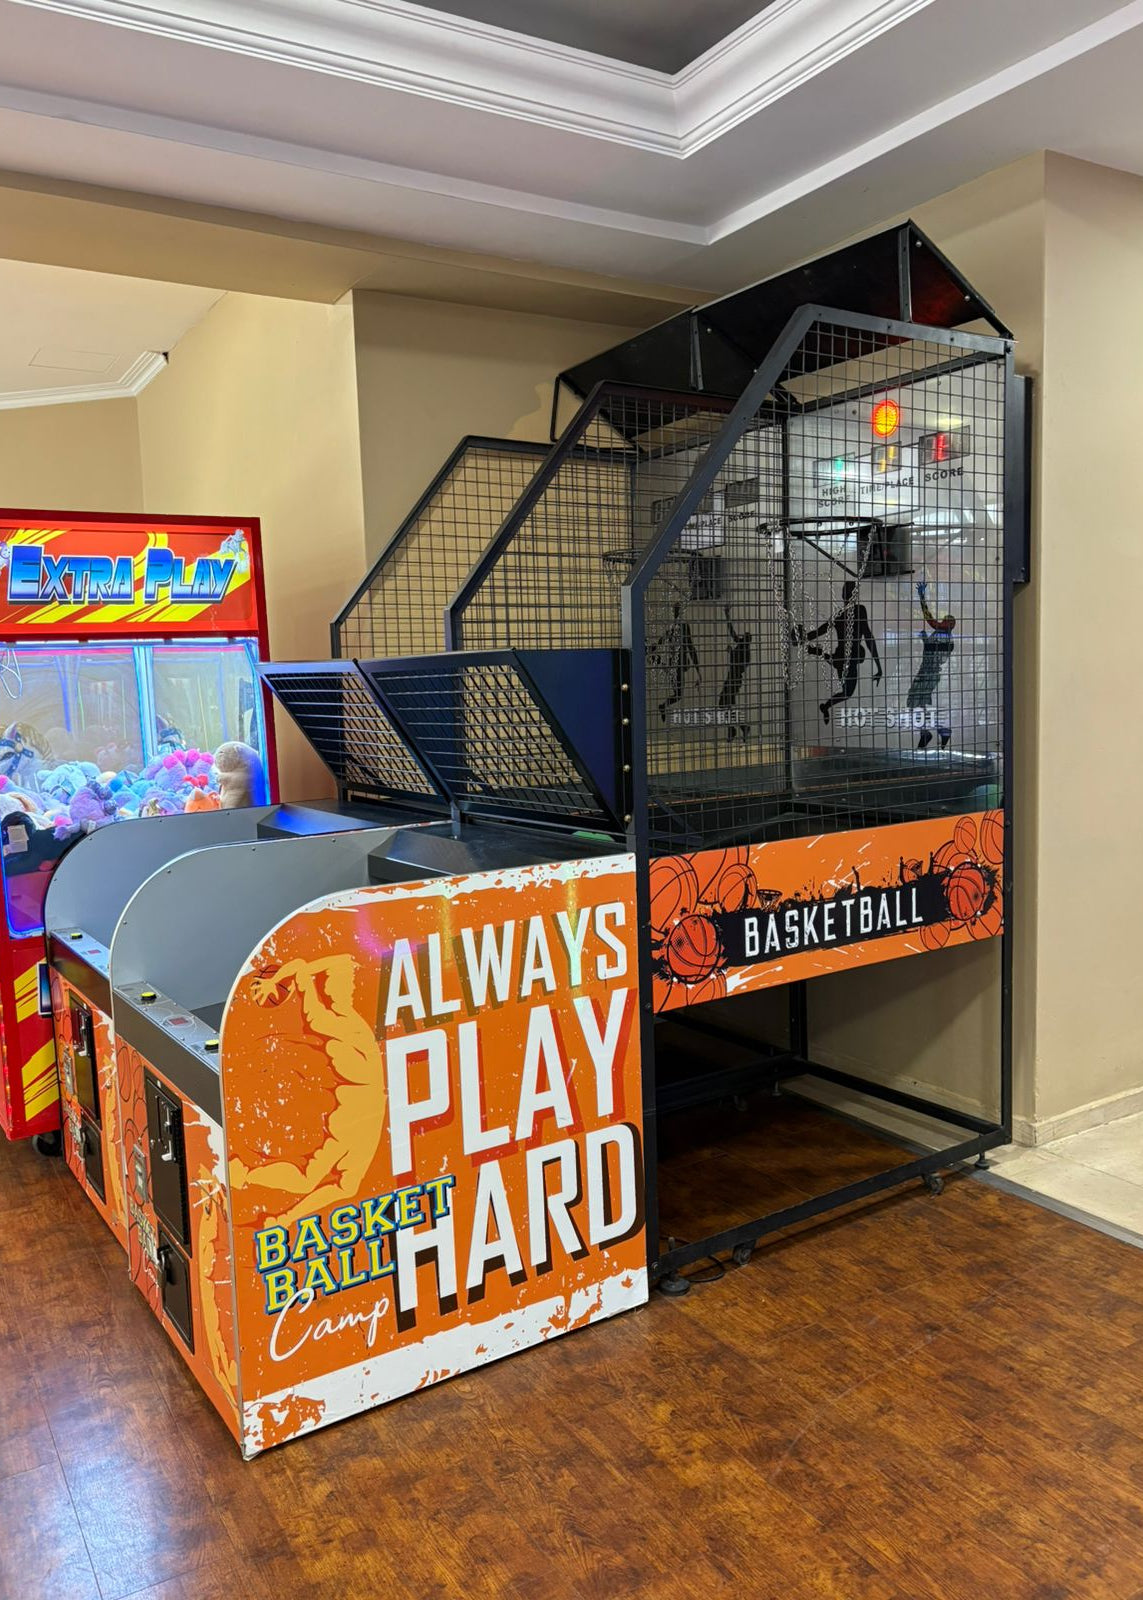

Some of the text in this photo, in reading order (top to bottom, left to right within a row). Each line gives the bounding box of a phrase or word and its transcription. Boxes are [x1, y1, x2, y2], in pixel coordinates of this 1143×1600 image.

[822, 485, 846, 496] HIGH
[924, 467, 963, 482] SCORE
[8, 544, 238, 605] EXTRA PLAY
[744, 887, 924, 958] BASKETBALL
[384, 901, 628, 1027] ALWAYS
[386, 987, 629, 1177] PLAY
[255, 1174, 456, 1273] BASKET
[390, 1122, 644, 1315] HARD
[263, 1239, 397, 1315] BALL
[269, 1287, 390, 1362] Camp
